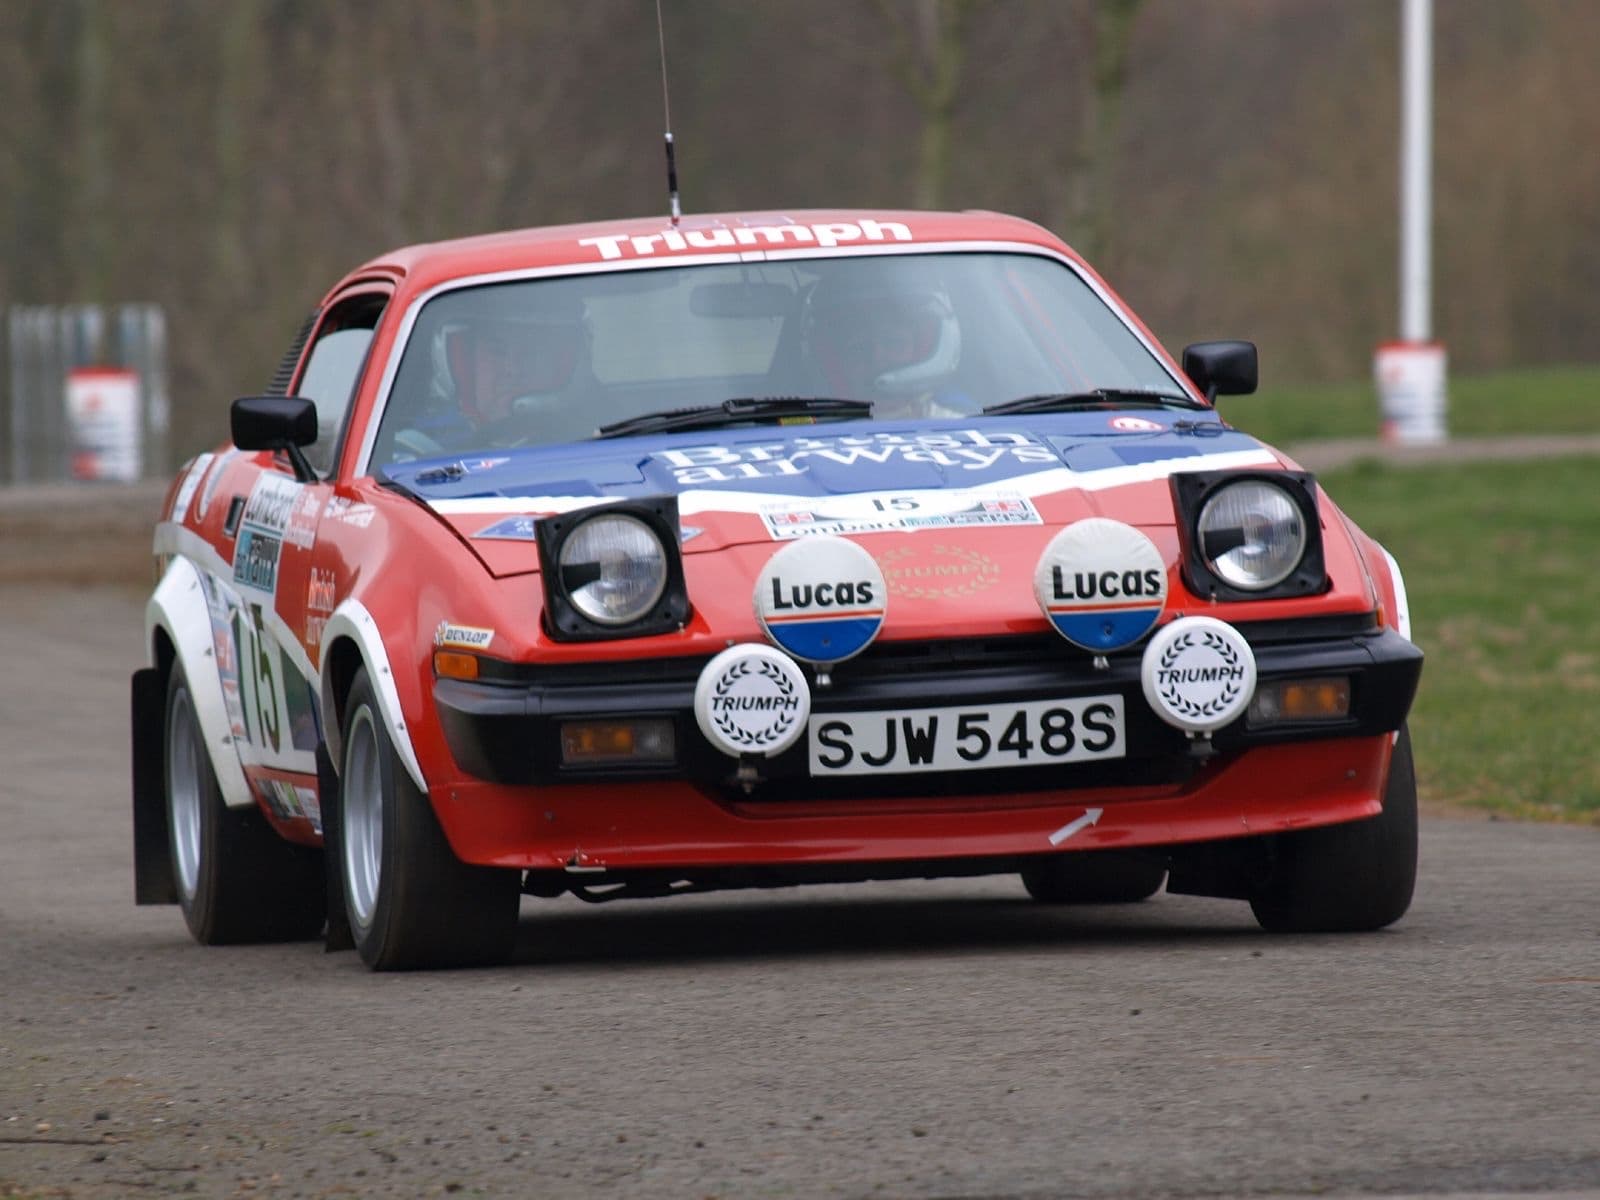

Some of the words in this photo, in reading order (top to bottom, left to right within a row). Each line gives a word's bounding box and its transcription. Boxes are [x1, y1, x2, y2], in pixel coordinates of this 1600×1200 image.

[578, 219, 913, 260] Triumph
[660, 430, 1040, 470] British
[672, 444, 1060, 484] airways
[872, 497, 920, 511] 15
[882, 564, 1000, 577] RIUMPH
[1052, 565, 1161, 600] Lucas
[772, 577, 875, 610] Lucas
[446, 628, 489, 645] DUNLOP
[1157, 666, 1244, 684] TRIUMPH
[711, 696, 799, 712] TRIUMPH
[817, 716, 939, 769] SJW
[957, 703, 1117, 761] 548S
